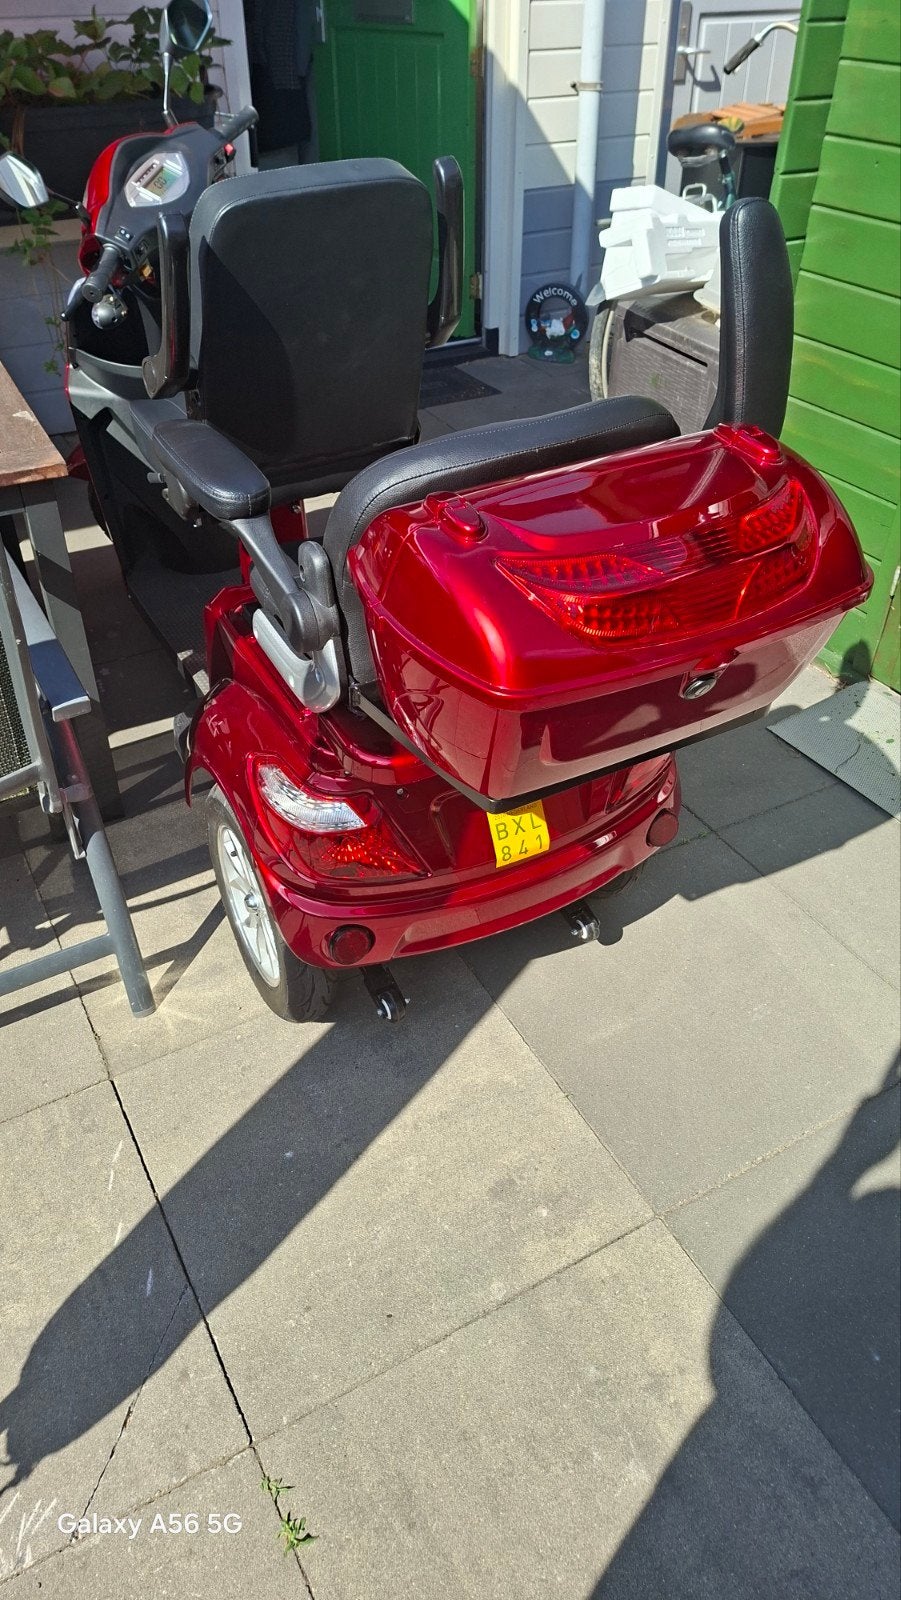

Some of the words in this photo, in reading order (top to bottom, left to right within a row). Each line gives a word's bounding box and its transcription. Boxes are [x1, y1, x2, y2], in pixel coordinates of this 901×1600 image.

[533, 287, 578, 306] Welcome
[495, 813, 542, 841] BXL
[501, 834, 543, 861] 841
